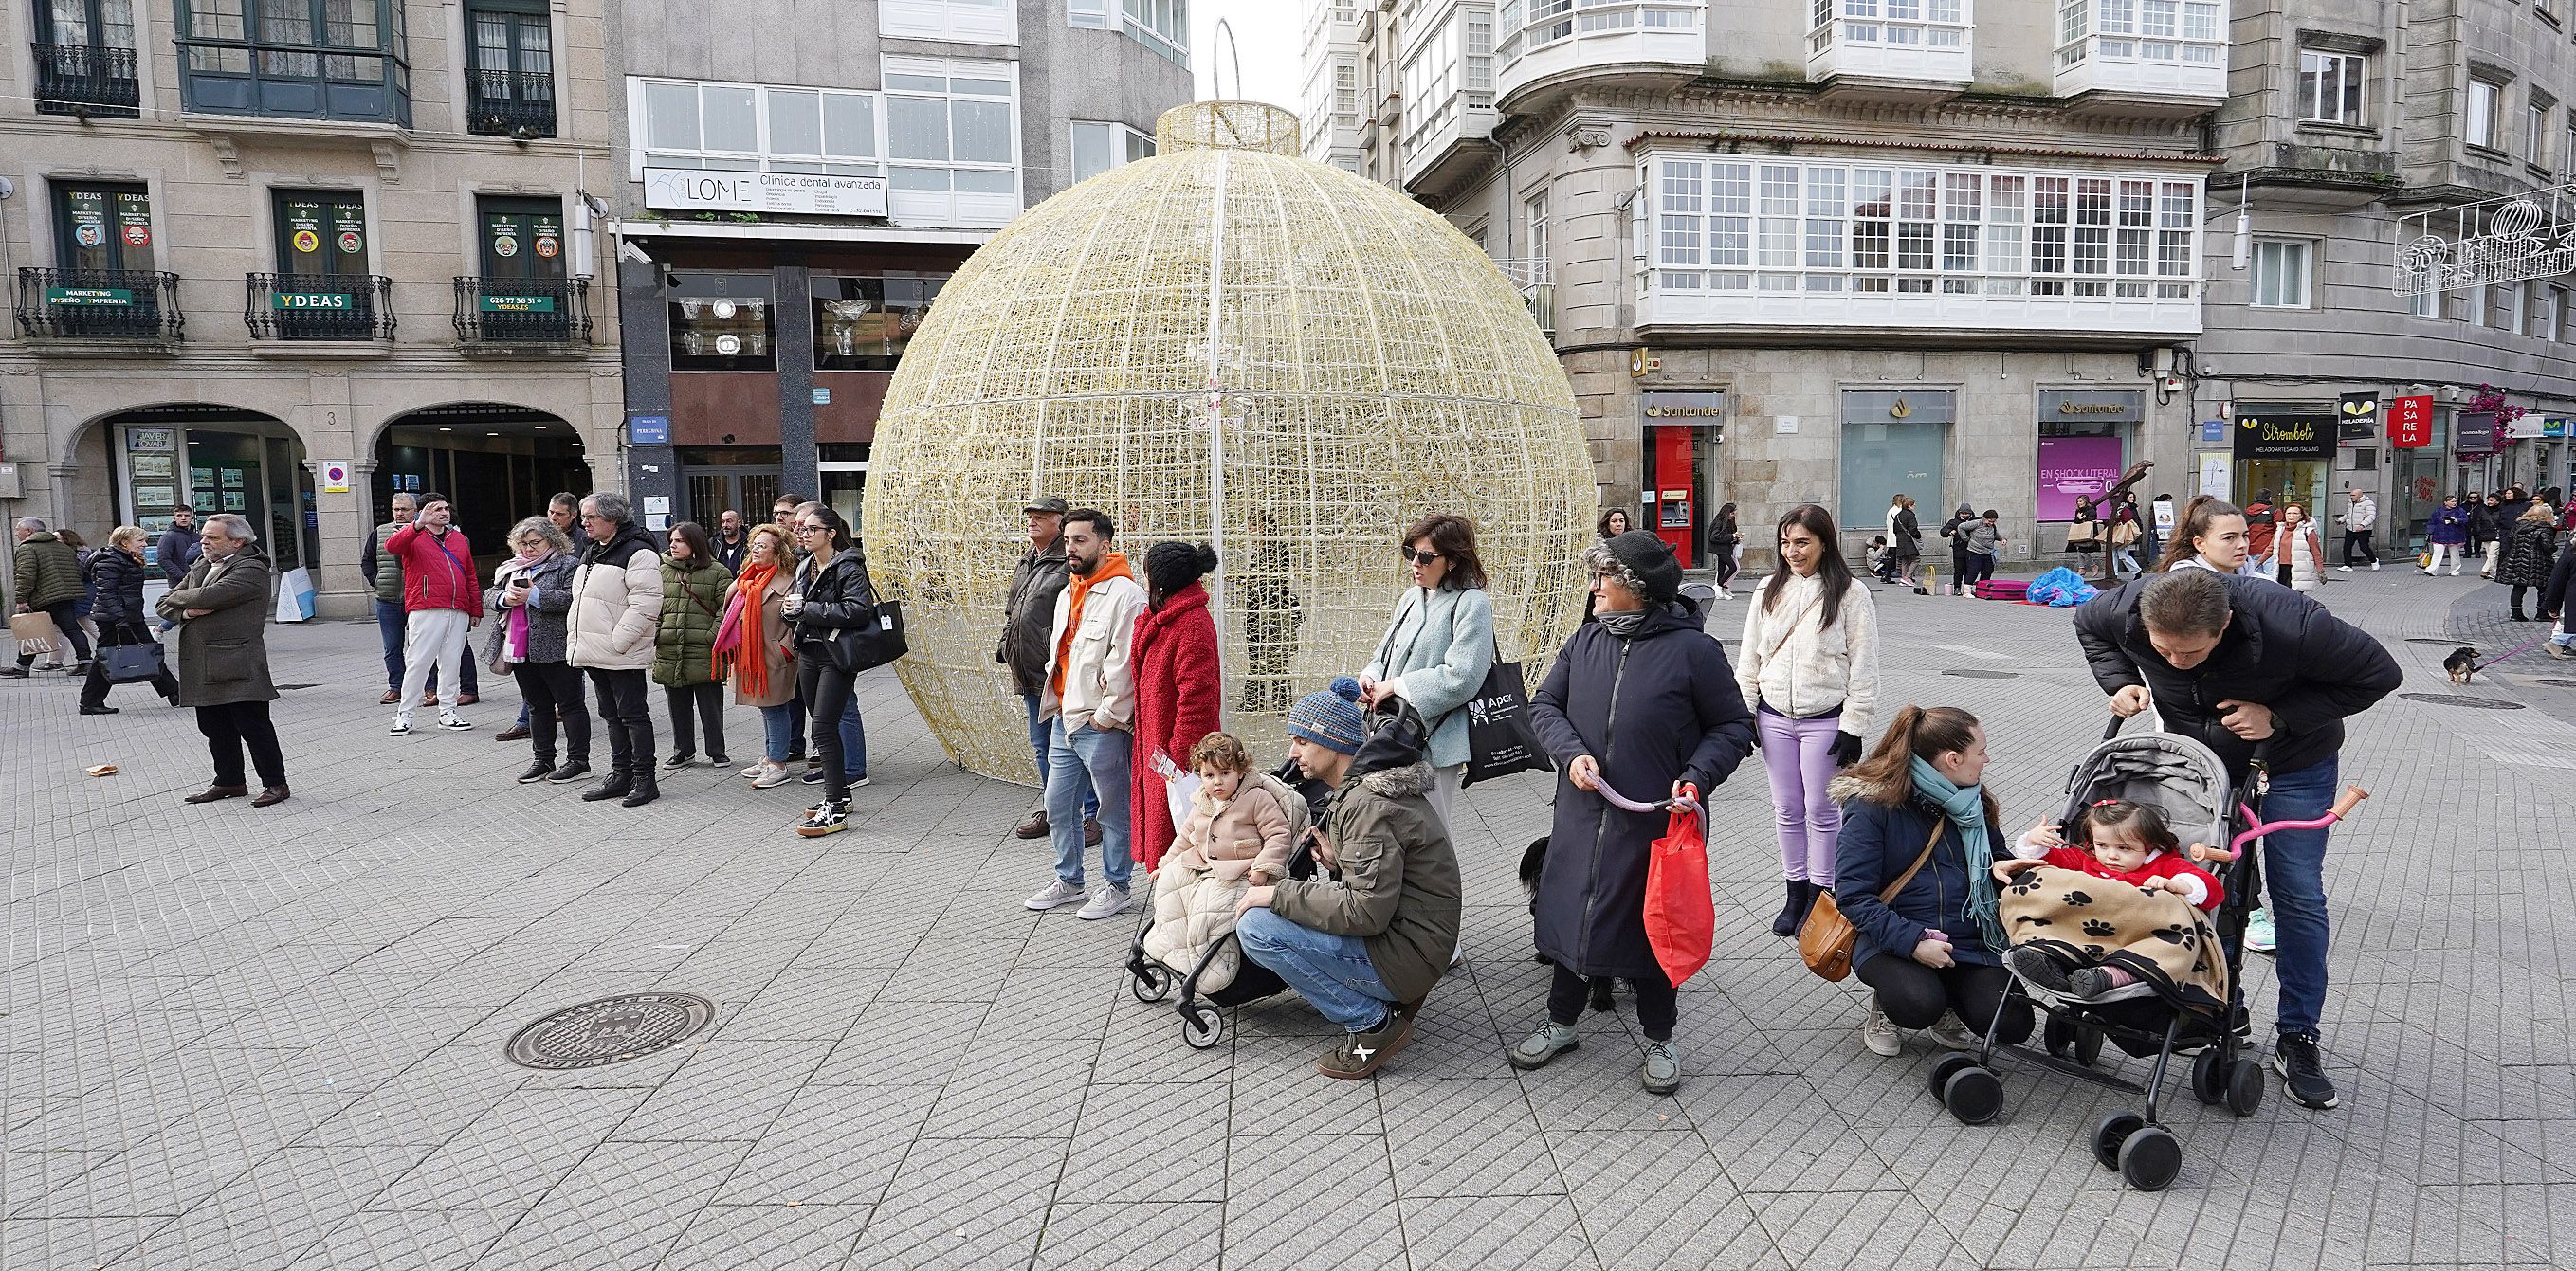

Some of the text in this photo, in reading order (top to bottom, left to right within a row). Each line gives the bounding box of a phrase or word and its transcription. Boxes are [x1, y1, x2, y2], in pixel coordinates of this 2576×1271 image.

[760, 175, 881, 190] Clínica dental avanzada
[687, 178, 751, 201] LOME
[69, 192, 102, 200] YDEAS
[281, 295, 343, 307] YDEAS
[2076, 404, 2125, 413] Santander
[2404, 399, 2417, 408] PA
[1663, 405, 1721, 417] Santander
[2404, 411, 2417, 420] SA
[327, 412, 336, 425] 3
[2263, 422, 2314, 440] Stromboli
[2403, 422, 2417, 431] RE
[2041, 469, 2118, 478] EN SHOCK LITERAL
[1489, 694, 1513, 708] Apex
